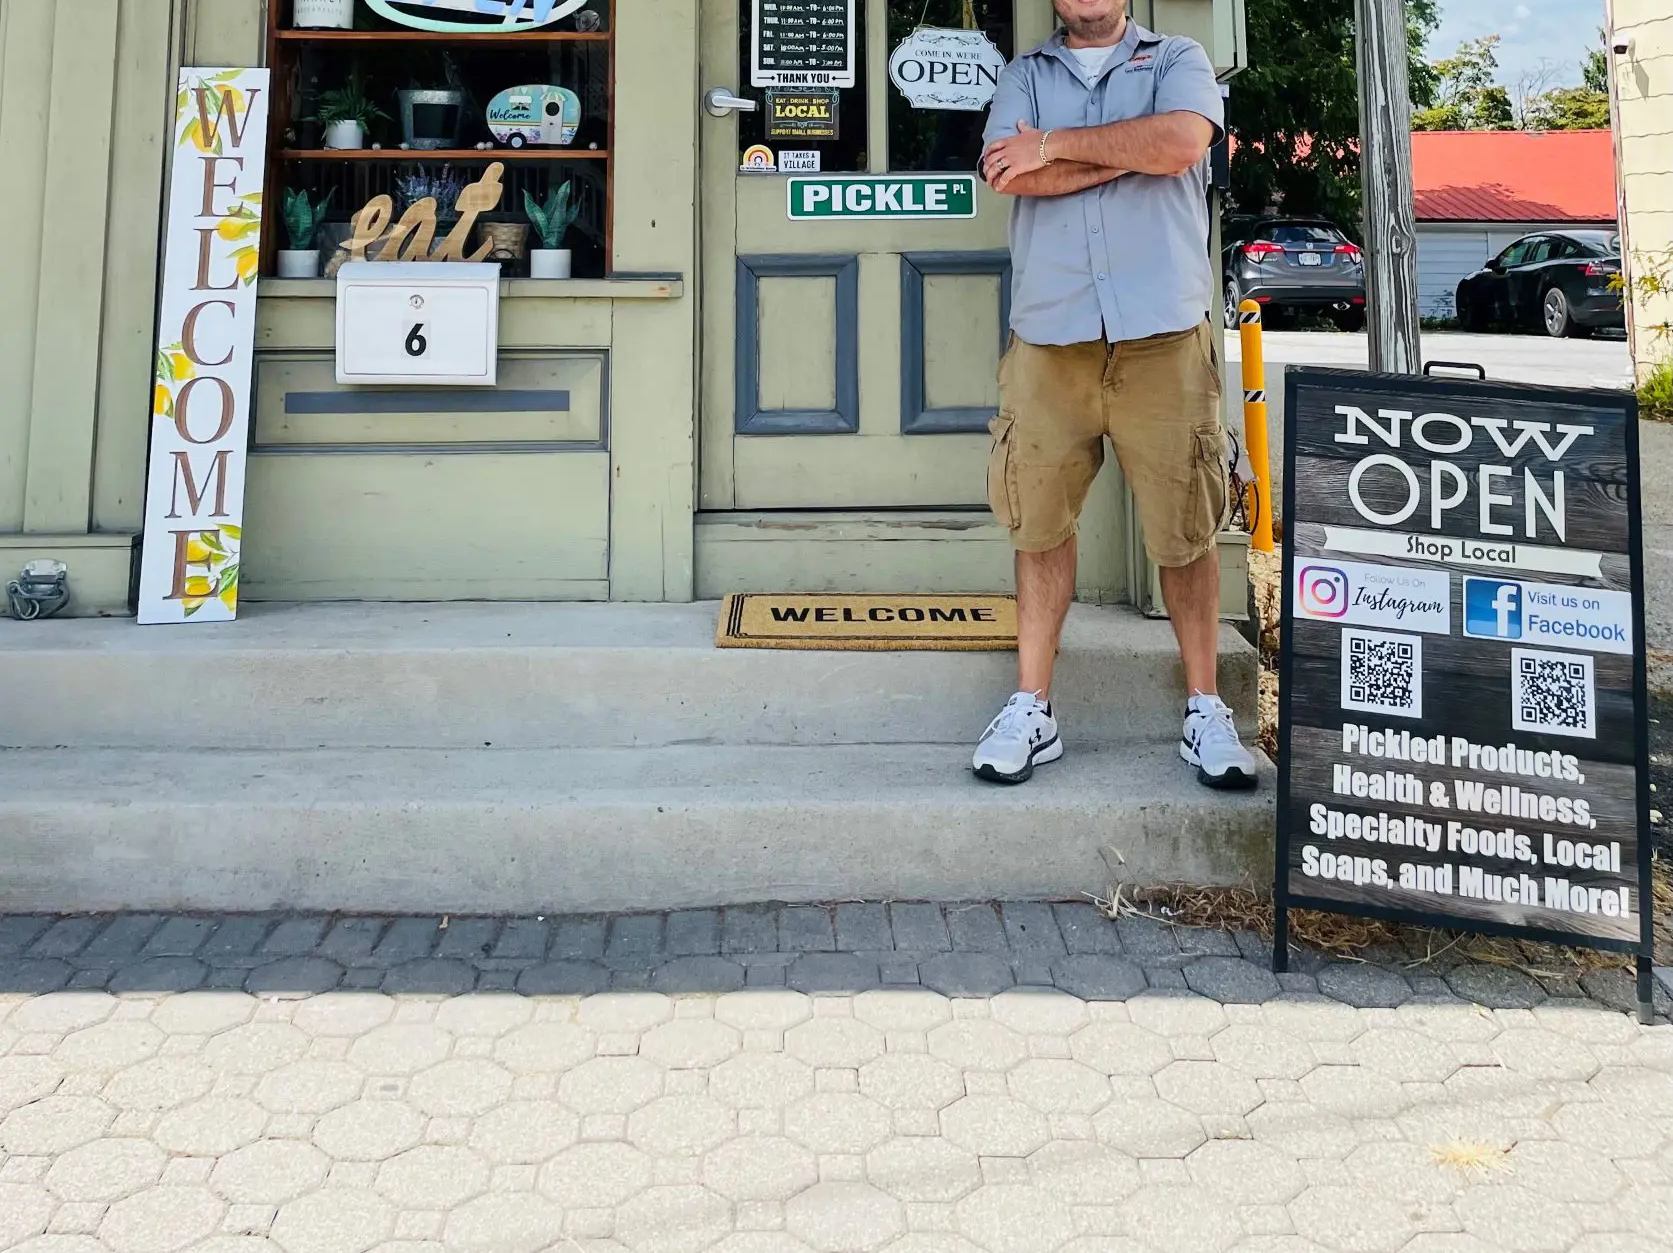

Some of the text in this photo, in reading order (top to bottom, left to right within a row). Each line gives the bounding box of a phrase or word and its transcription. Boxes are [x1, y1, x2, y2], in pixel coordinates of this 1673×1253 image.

[776, 73, 830, 83] THANK YOU
[897, 59, 1001, 87] OPEN
[489, 109, 532, 120] Welcome
[775, 106, 830, 118] LOCAL
[784, 160, 815, 169] VILLAGE
[803, 183, 966, 213] PICKLE PL
[162, 88, 261, 601] WELCOME
[404, 323, 427, 357] 6
[1334, 405, 1594, 461] NOW
[1348, 453, 1566, 543] OPEN
[1406, 535, 1517, 564] Shop Local
[1364, 573, 1426, 588] Follow Us On
[770, 607, 997, 622] WELCOME
[1352, 586, 1444, 620] Instagram
[1528, 590, 1600, 610] Visit us on
[1528, 614, 1625, 642] Facebook
[1341, 723, 1585, 785] Pickled Products,
[1332, 763, 1597, 830] Health & Wellness,
[1309, 802, 1621, 874] Specialty Foods, Local
[1301, 844, 1630, 919] Soaps, and Much More!
